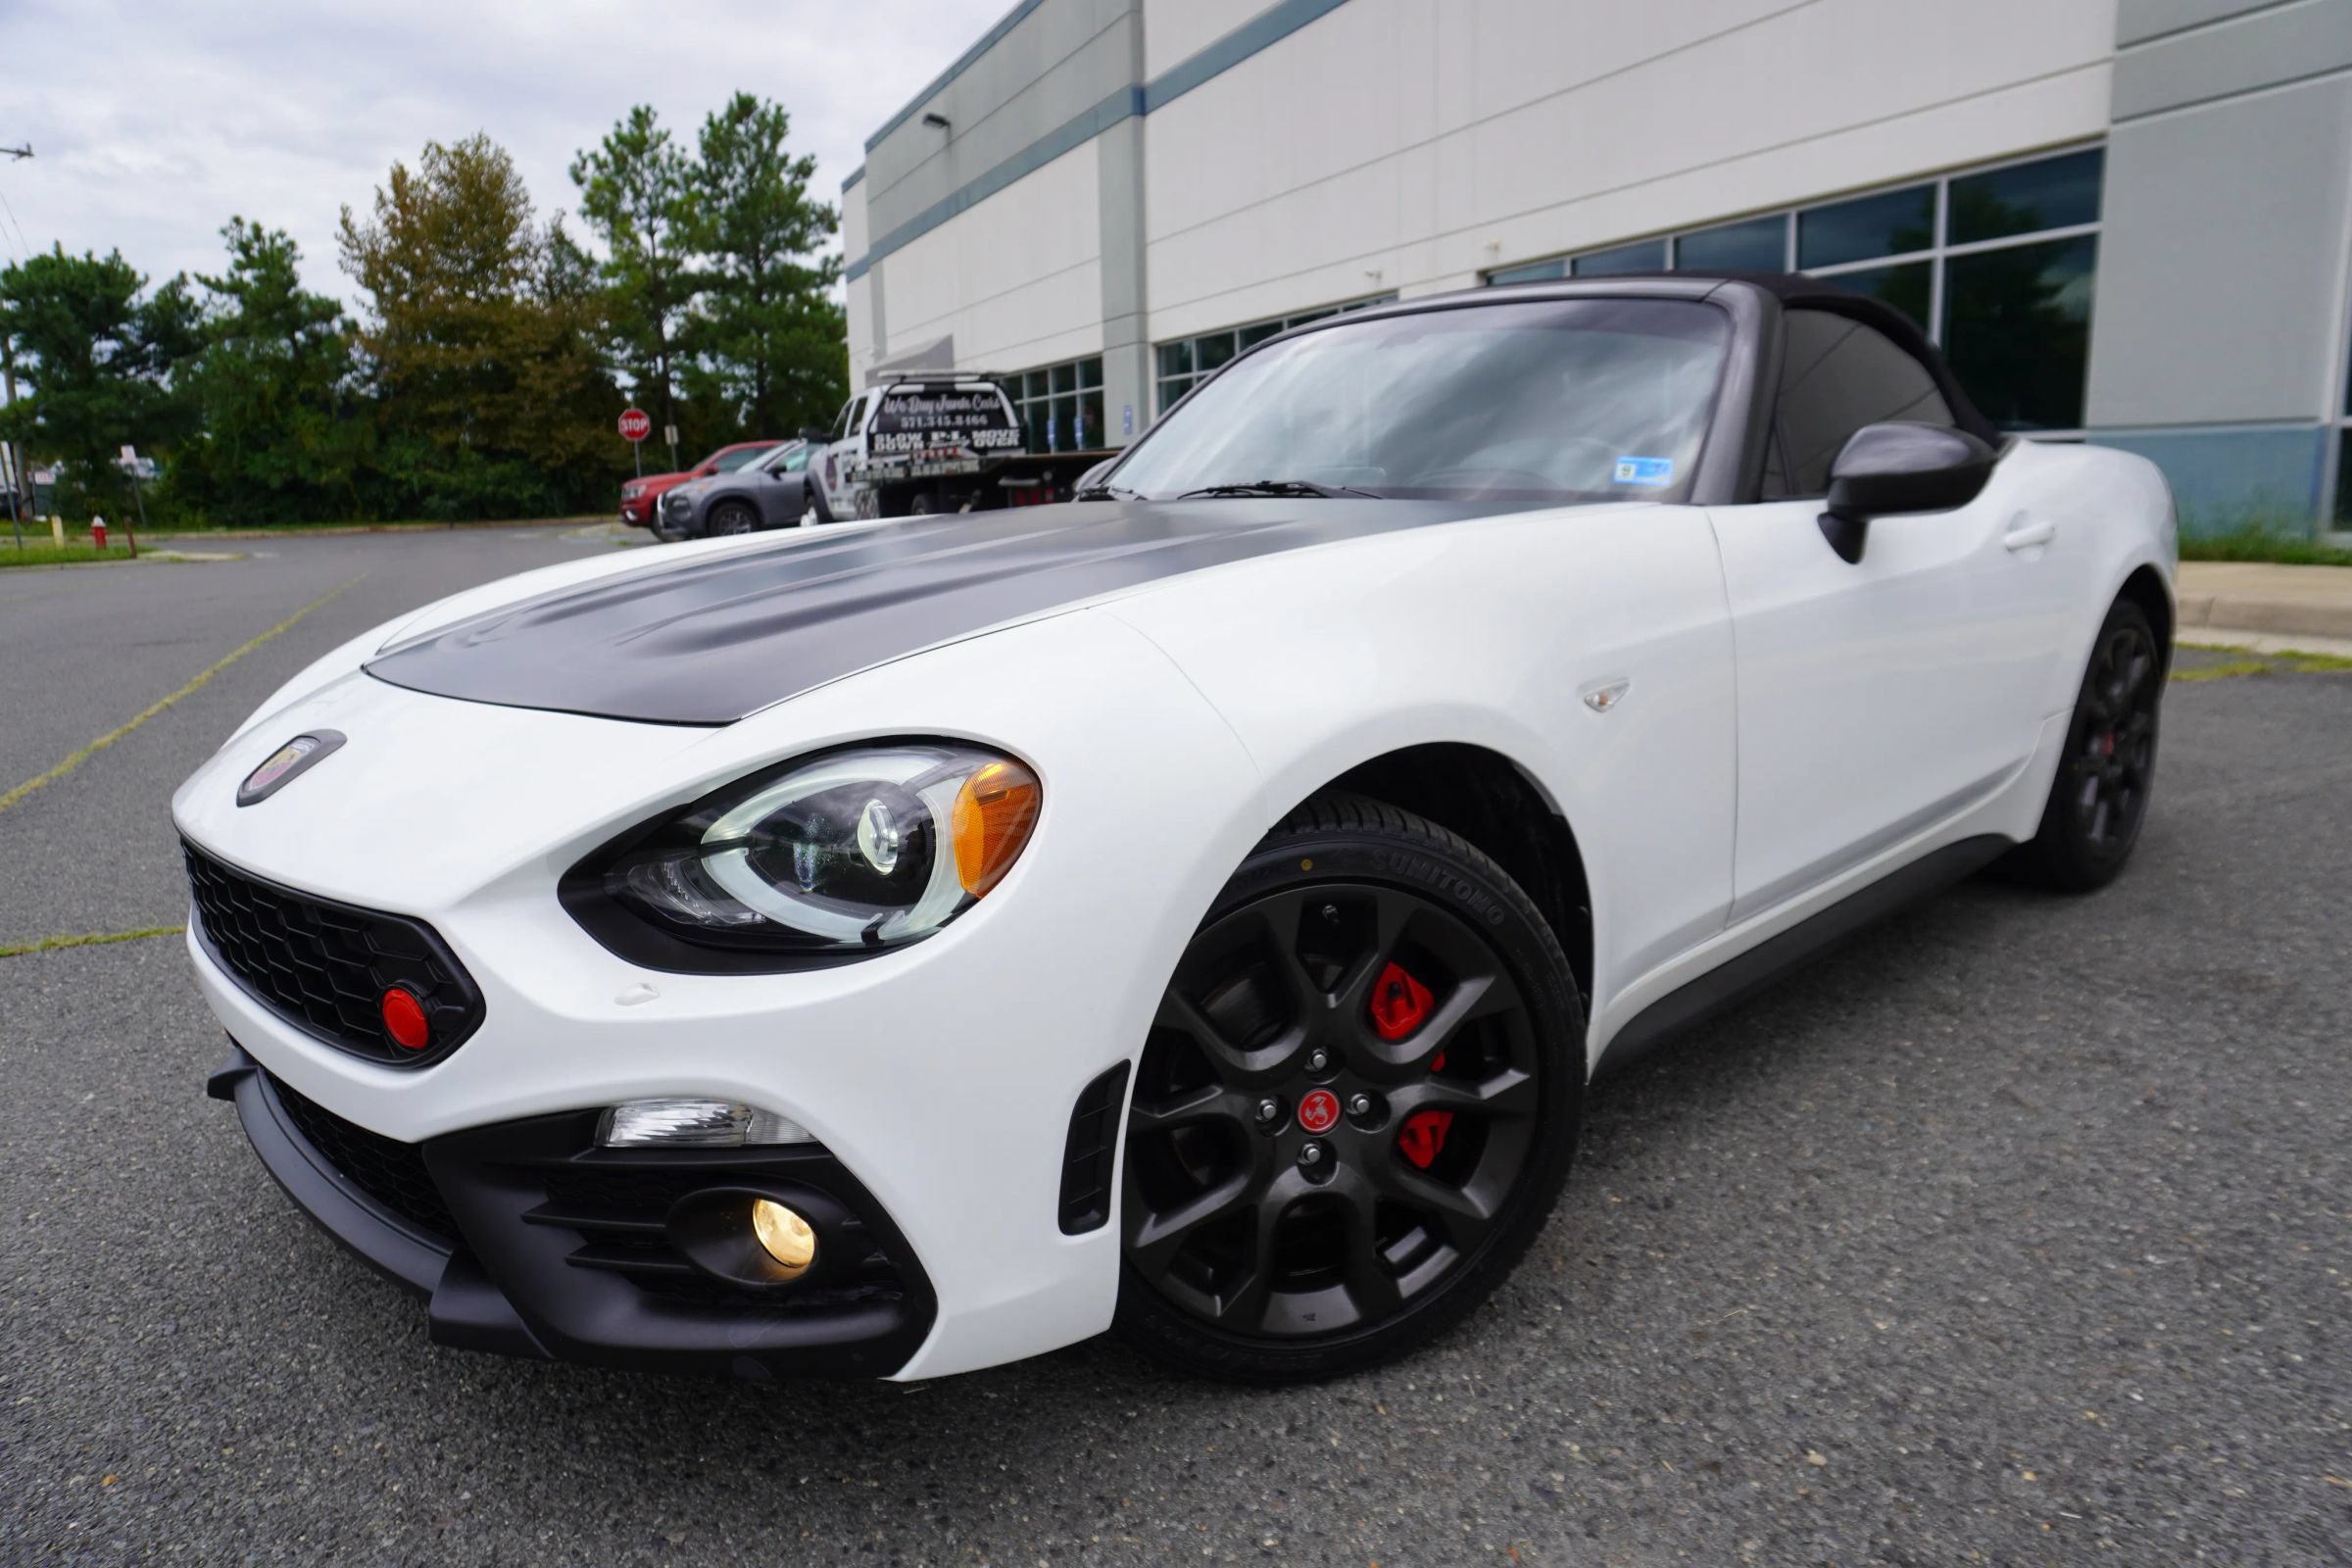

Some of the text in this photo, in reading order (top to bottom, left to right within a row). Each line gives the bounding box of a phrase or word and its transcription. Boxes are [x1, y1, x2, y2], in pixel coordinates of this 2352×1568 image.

[885, 393, 1001, 416] We Buy Junk Cars
[620, 417, 647, 432] STOP
[972, 429, 1020, 440] MOVE
[973, 438, 1019, 448] OVER
[1369, 849, 1506, 925] SUMITOMO
